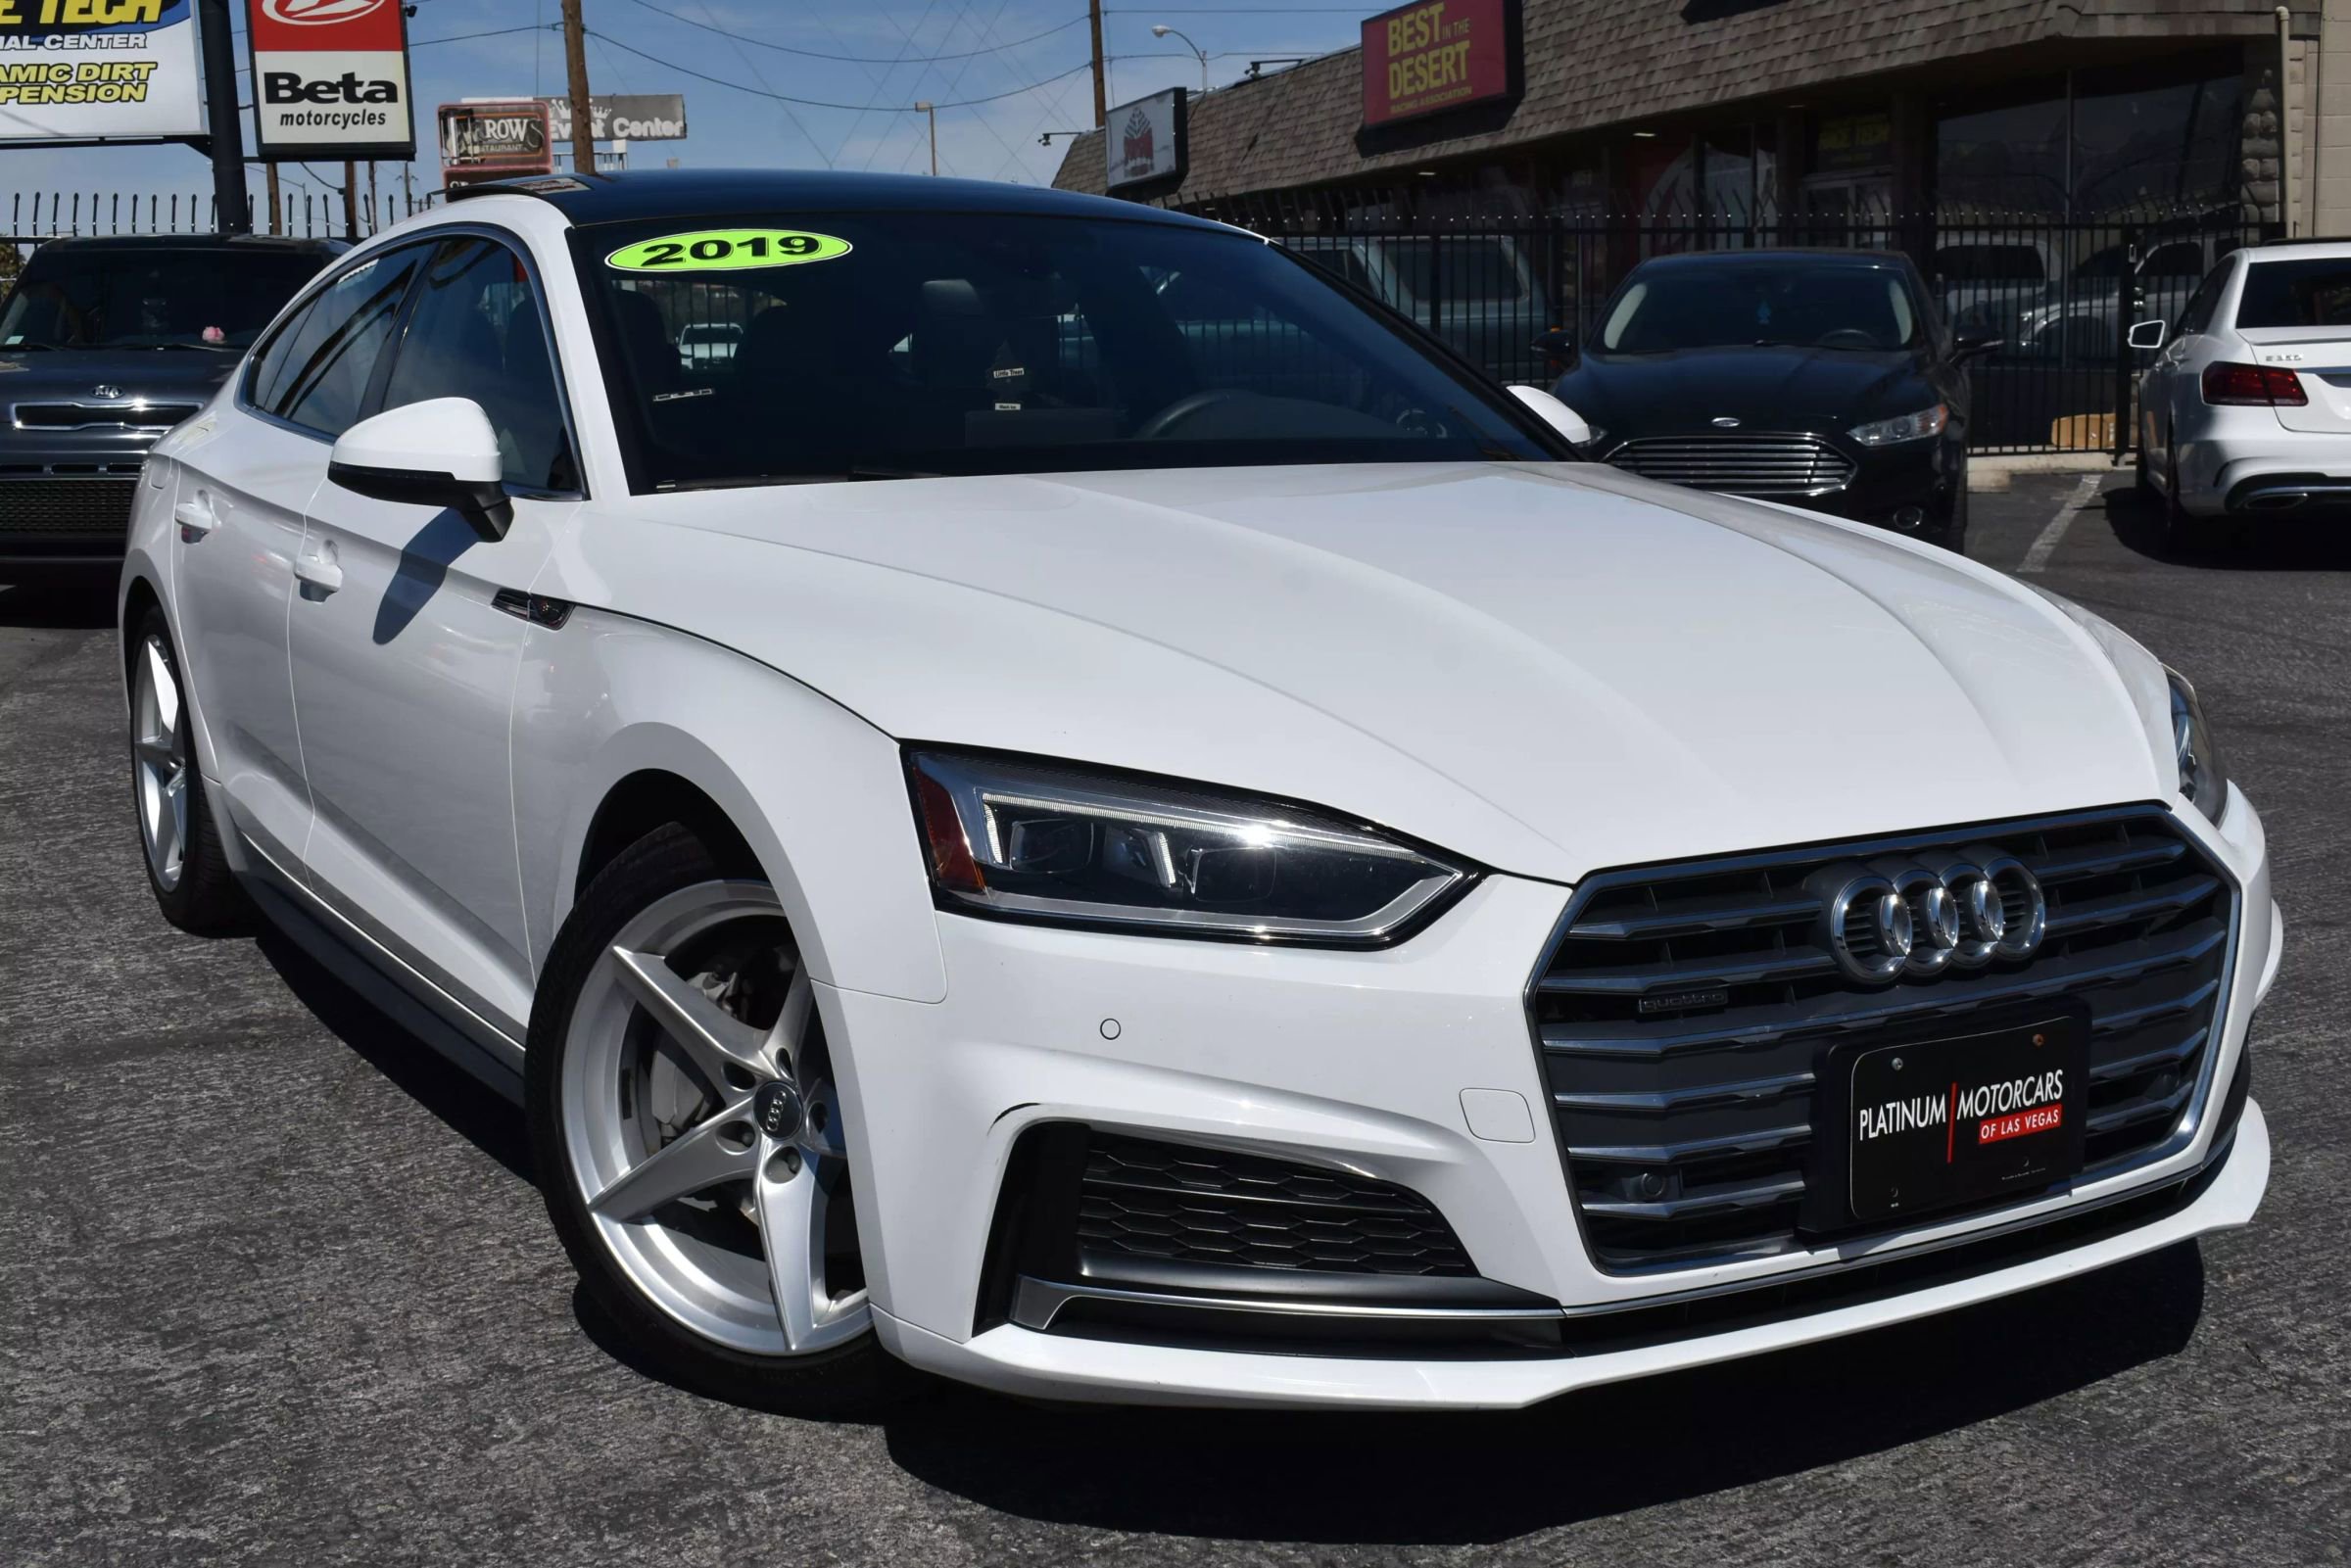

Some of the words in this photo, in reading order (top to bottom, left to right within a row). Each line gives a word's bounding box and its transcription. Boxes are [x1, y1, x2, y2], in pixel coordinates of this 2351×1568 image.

[44, 33, 148, 50] CENTER
[1387, 2, 1445, 57] BEST
[1442, 24, 1451, 39] IN
[1454, 18, 1470, 33] THE
[76, 62, 158, 82] DIRT
[1388, 39, 1470, 100] DESERT
[264, 71, 399, 104] Beta
[280, 109, 386, 130] motorcycles
[612, 117, 684, 137] Center
[640, 235, 823, 267] 2019
[1859, 1093, 1946, 1141] PLATINUM
[1957, 1069, 2063, 1120] MOTORCARS
[1981, 1123, 1996, 1139] OF
[2001, 1118, 2020, 1135] LAS
[2025, 1109, 2059, 1129] VEGAS
